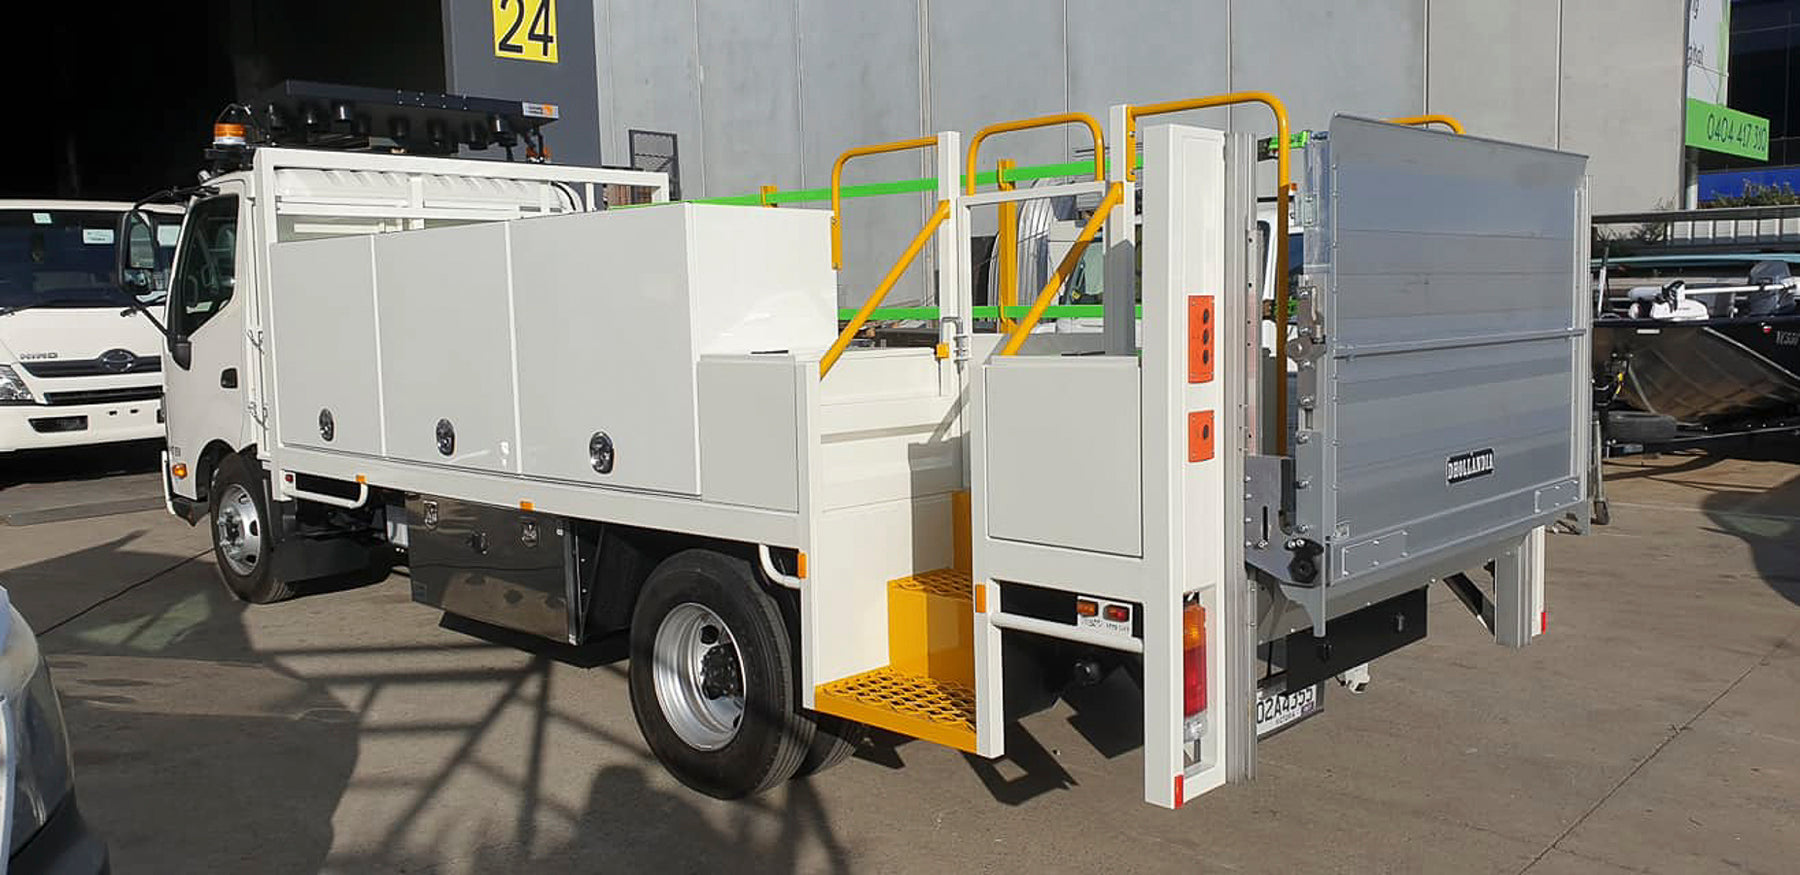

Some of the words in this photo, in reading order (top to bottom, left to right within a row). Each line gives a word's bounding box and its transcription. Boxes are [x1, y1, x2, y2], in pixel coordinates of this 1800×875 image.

[499, 0, 554, 57] 24
[1706, 113, 1734, 143] 0404
[1448, 453, 1494, 480] DHOLLANDIA
